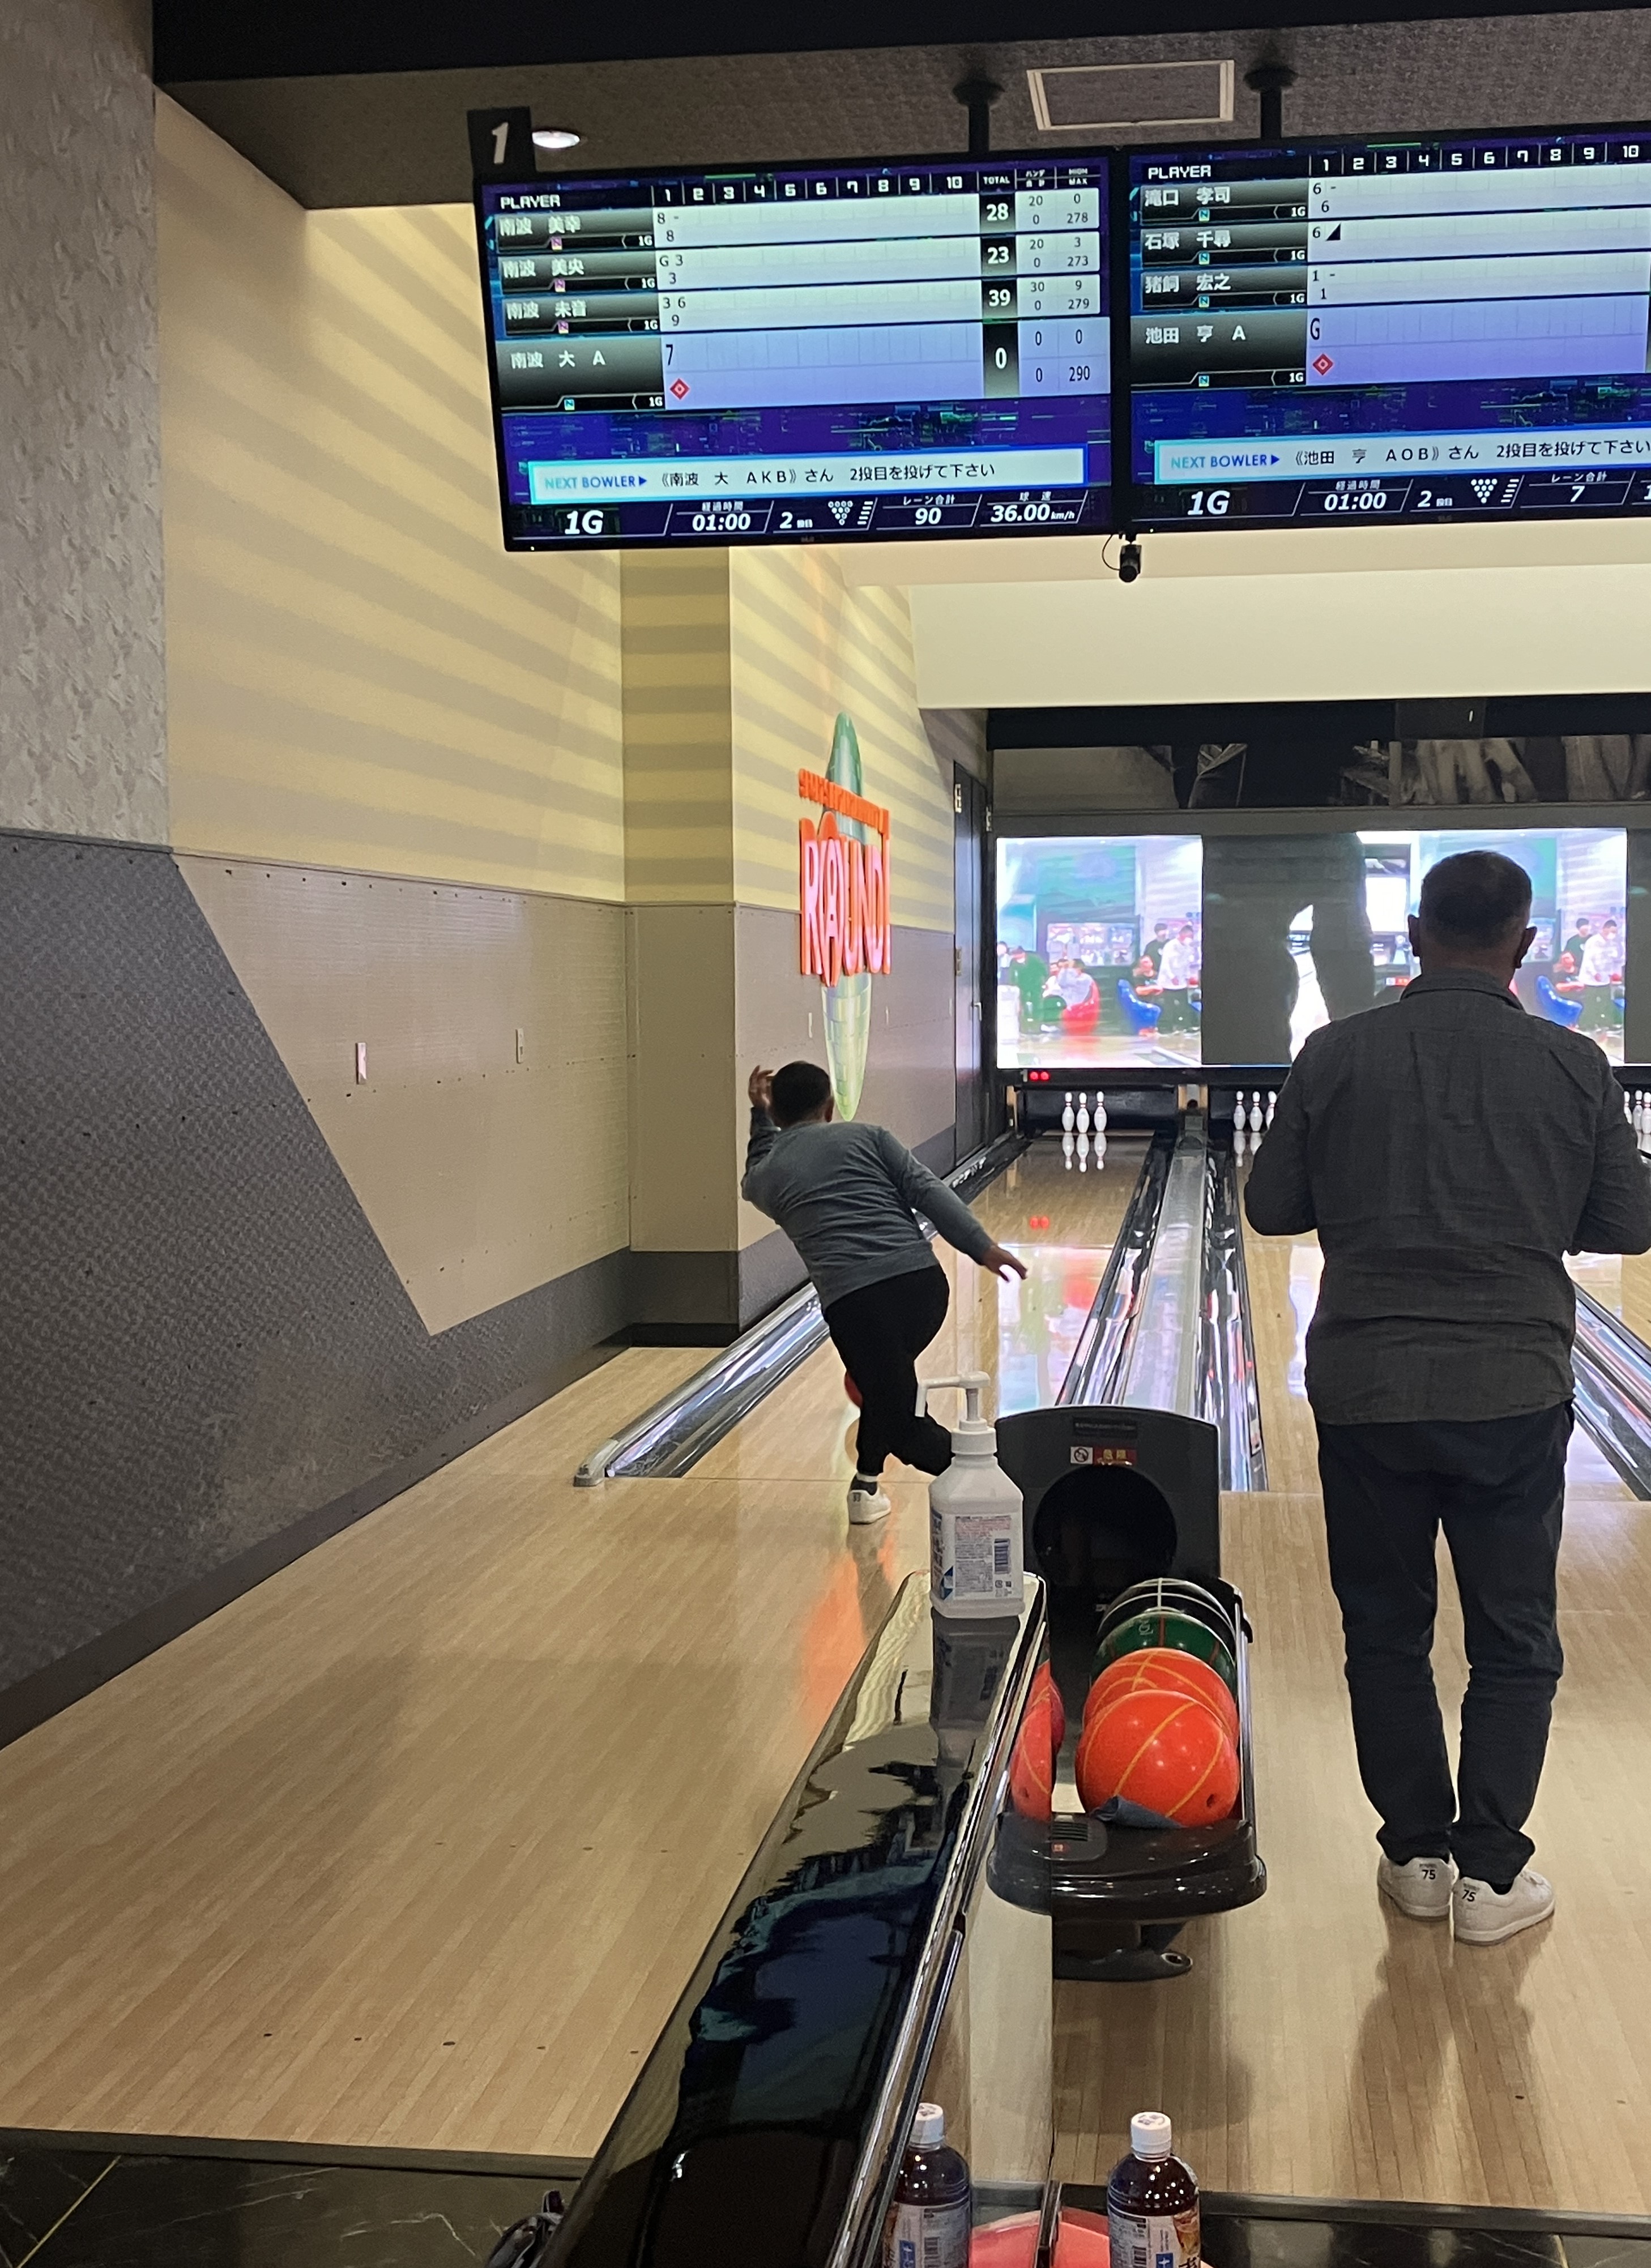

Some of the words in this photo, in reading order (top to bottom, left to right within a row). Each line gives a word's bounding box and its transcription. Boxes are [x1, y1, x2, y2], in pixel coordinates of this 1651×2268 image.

[492, 122, 508, 164] 1
[1148, 165, 1211, 179] PLAYER
[1324, 159, 1329, 171] 1
[1353, 157, 1364, 170] 2
[1386, 156, 1397, 168] 3
[1418, 155, 1429, 166] 4
[1451, 153, 1462, 165] 5
[1484, 152, 1495, 164] 6
[1517, 150, 1528, 163] 7
[1550, 148, 1562, 161] 8
[1584, 147, 1594, 159] 9
[1623, 145, 1639, 158] 10
[500, 194, 560, 210] PLAYER
[664, 190, 671, 202] 1
[693, 188, 704, 201] 2
[723, 186, 735, 199] 3
[754, 185, 766, 198] 4
[785, 183, 796, 197] 5
[816, 182, 827, 195] 6
[847, 181, 858, 194] 7
[878, 180, 889, 192] 8
[909, 178, 920, 191] 9
[946, 176, 962, 189] 10
[983, 176, 1010, 185] TOTAL
[1313, 183, 1321, 194] 6
[1029, 196, 1043, 206] 20
[1074, 194, 1081, 204] 0
[1291, 207, 1306, 217] 1G
[1321, 200, 1329, 212] 6
[658, 213, 665, 224] 8
[987, 204, 1009, 221] 28
[1067, 212, 1088, 223] 278
[1033, 215, 1039, 225] 0
[667, 230, 674, 241] 8
[1313, 227, 1321, 238] 6
[638, 236, 652, 246] 1G
[1030, 239, 1044, 249] 20
[1074, 237, 1081, 247] 3
[660, 255, 668, 267] G
[676, 255, 683, 266] 3
[988, 247, 1009, 264] 23
[1068, 256, 1089, 266] 273
[1291, 250, 1305, 260] 1G
[1034, 258, 1040, 268] 0
[669, 274, 676, 284] 3
[1196, 273, 1231, 291] 宏之
[1313, 271, 1318, 281] 1
[642, 279, 655, 289] 1G
[1031, 282, 1044, 292] 30
[1076, 280, 1082, 290] 9
[989, 290, 1010, 306] 39
[1291, 294, 1305, 304] 1G
[1321, 288, 1326, 299] 1
[663, 297, 671, 308] 3
[678, 297, 685, 307] 6
[1035, 301, 1041, 310] 0
[1069, 298, 1089, 309] 279
[645, 320, 658, 330] 1G
[672, 315, 679, 326] 9
[1146, 327, 1179, 344] 池田
[1232, 326, 1245, 340] A
[1310, 318, 1320, 340] G
[1036, 332, 1042, 345] 0
[1076, 330, 1082, 343] 0
[511, 352, 543, 369] 南波
[558, 351, 575, 367] 大
[592, 351, 605, 365] A
[666, 344, 673, 365] 7
[995, 348, 1007, 368] 0
[1036, 369, 1043, 382] 0
[1069, 366, 1090, 381] 290
[1290, 373, 1303, 383] 1G
[649, 397, 663, 407] 1G
[1171, 456, 1205, 468] NEXT
[1210, 454, 1267, 467] BOWLER
[545, 477, 578, 490] NEXT
[582, 476, 635, 488] BOWLER
[715, 471, 728, 485] 大
[850, 464, 995, 481] 2投目を投げて下さい
[1552, 471, 1607, 483] レーン合計
[1418, 490, 1432, 507] 2
[1570, 485, 1585, 502] 7
[903, 494, 955, 506] レーン合計
[1188, 490, 1230, 515] 1G
[1324, 492, 1387, 511] 01:00
[915, 507, 942, 525] 90
[991, 504, 1050, 523] 36.00
[1051, 511, 1075, 520] km/h
[565, 510, 604, 534] 1G
[692, 513, 751, 531] 01:00
[779, 511, 793, 529] 2
[1020, 1069, 1028, 1082] 1
[1421, 1869, 1436, 1880] 75
[1462, 1889, 1477, 1902] 75
